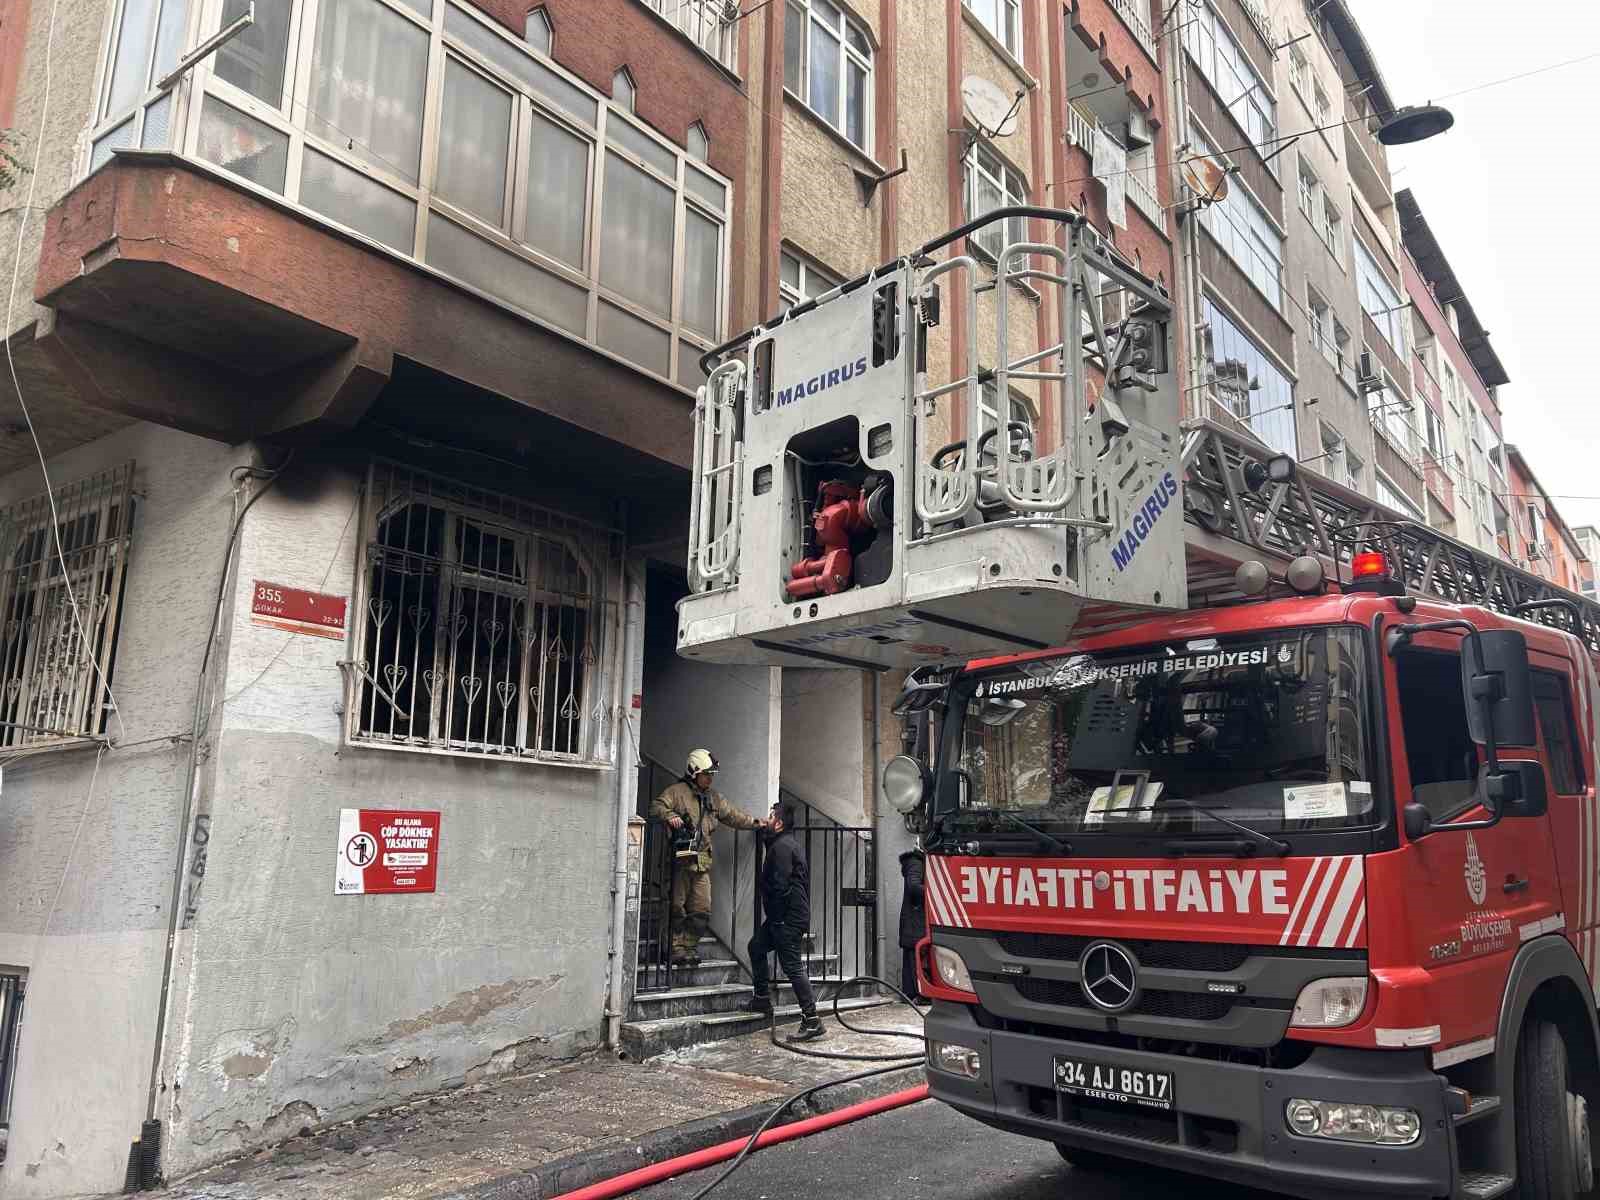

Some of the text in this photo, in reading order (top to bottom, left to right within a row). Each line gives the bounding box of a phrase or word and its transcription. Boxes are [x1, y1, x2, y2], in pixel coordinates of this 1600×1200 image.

[777, 357, 867, 407] MAGIRUS
[1111, 472, 1177, 572] MAGIRUS
[989, 676, 1053, 696] İSTANBUL
[1163, 647, 1268, 673] BELEDİYESİ
[385, 838, 429, 849] YASAKTIR!
[399, 826, 433, 838] DÖKMEK
[1064, 1062, 1168, 1098] 34 AJ 8617
[1085, 1089, 1106, 1100] ESER
[1107, 1092, 1128, 1103] OTO
